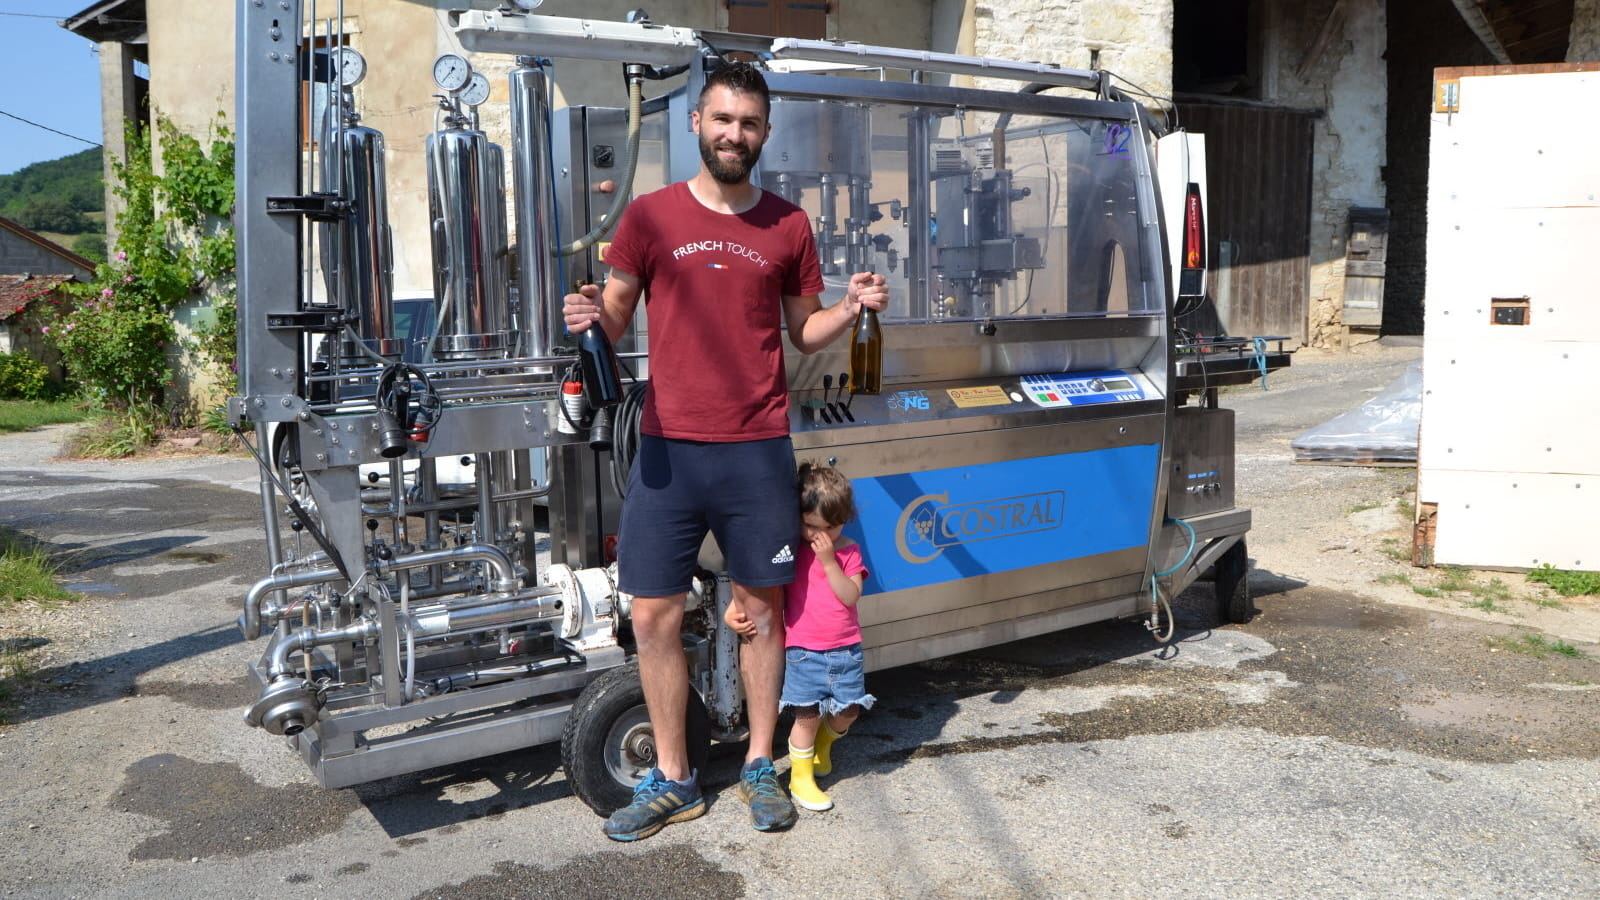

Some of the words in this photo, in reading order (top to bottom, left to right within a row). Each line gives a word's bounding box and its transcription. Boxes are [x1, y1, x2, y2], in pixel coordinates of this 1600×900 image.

[782, 151, 789, 161] 5
[672, 241, 723, 260] FRENCH
[726, 241, 766, 267] TOUCH
[941, 498, 1056, 539] COSTRAL
